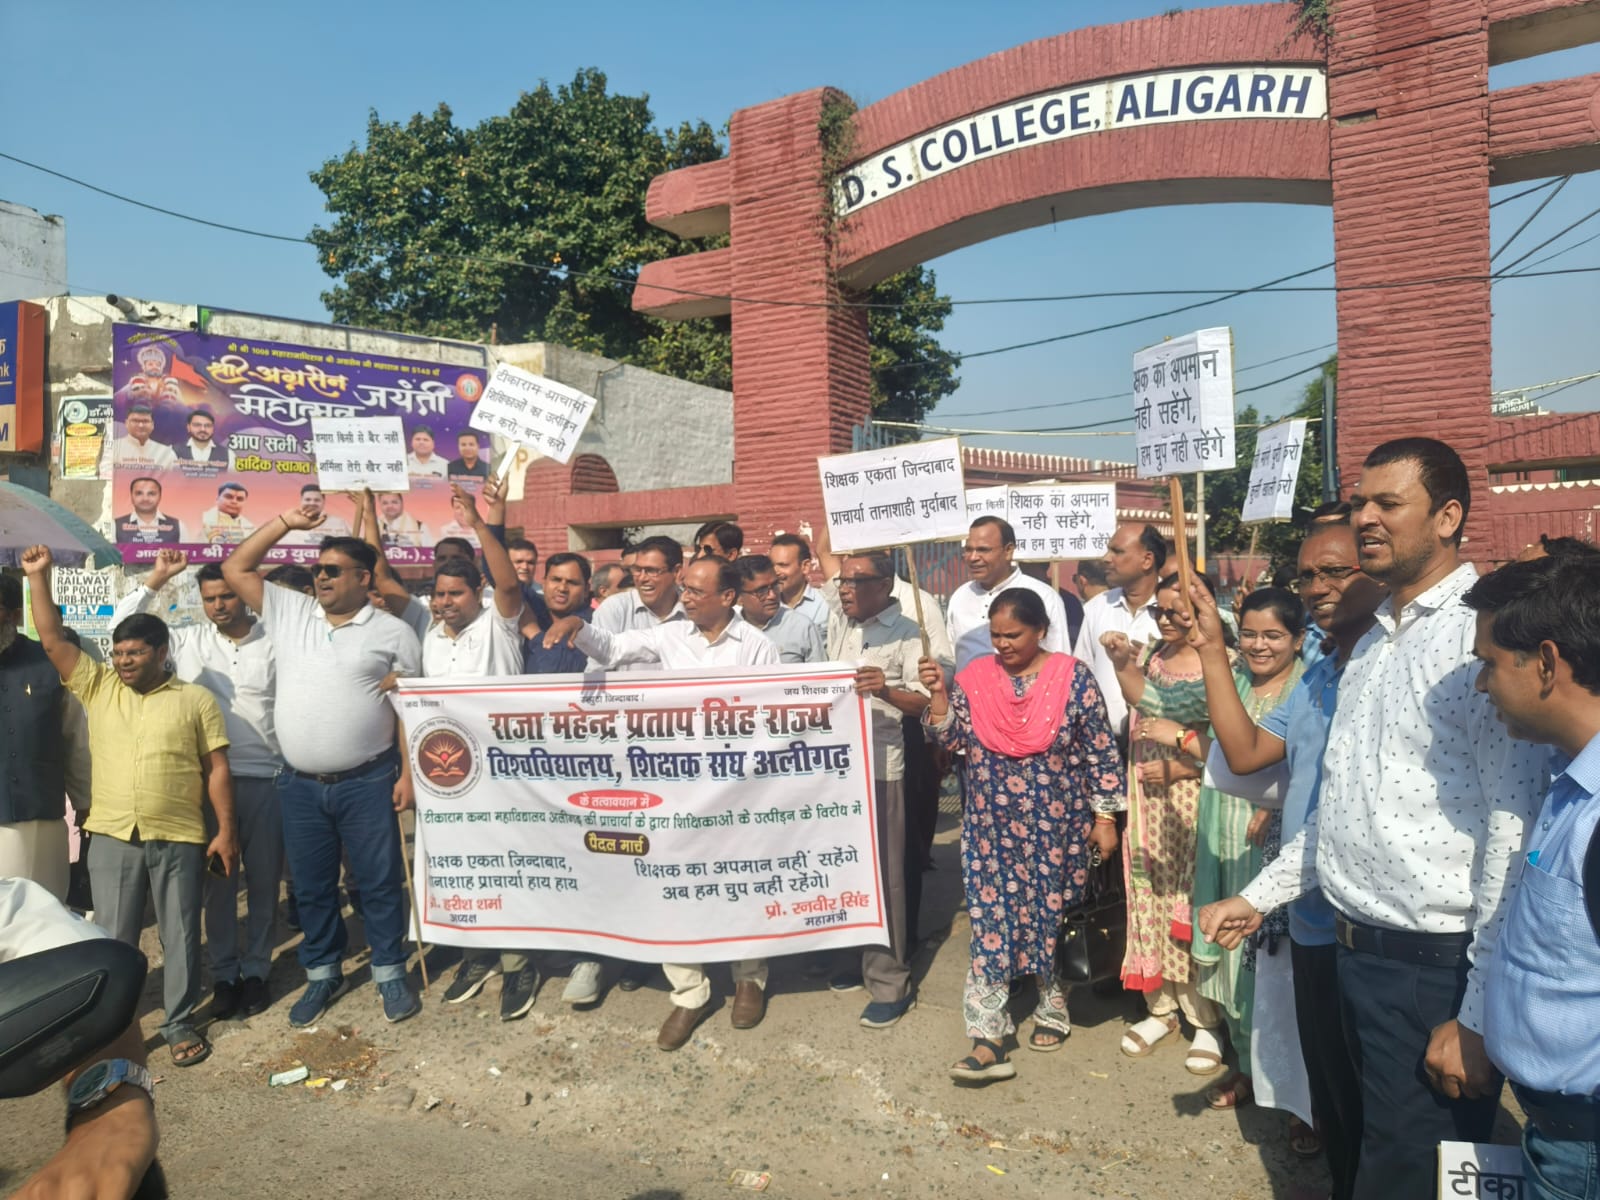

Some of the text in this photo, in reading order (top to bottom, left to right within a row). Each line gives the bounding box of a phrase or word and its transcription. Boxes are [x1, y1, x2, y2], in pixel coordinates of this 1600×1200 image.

[841, 74, 1312, 209] D. S. COLLEGE, ALIGARH
[1170, 350, 1219, 383] अपमान
[353, 379, 454, 416] जयंती
[496, 369, 587, 414] टीकाराम प्राचार्या
[1157, 387, 1197, 424] सहेंगे,
[229, 433, 260, 450] आप
[264, 433, 297, 453] सभी
[547, 436, 566, 452] करो
[1192, 427, 1226, 460] रहेंगे
[236, 455, 272, 472] हार्दिक
[275, 460, 311, 473] स्वागत
[824, 457, 956, 489] शिक्षक एकता जिन्दाबाद
[830, 491, 958, 526] प्राचार्या तानाशाही मुर्दाबाद
[986, 498, 1005, 511] किसी
[1009, 490, 1044, 510] शिक्षक
[1070, 492, 1110, 508] अपमान
[1021, 510, 1095, 531] नही सहेंगे,
[202, 544, 223, 557] श्री
[1031, 538, 1045, 551] हम
[1049, 537, 1065, 555] चुप
[1069, 533, 1087, 550] नही
[57, 576, 110, 585] RAILWAY
[57, 586, 111, 595] UP POLICE
[66, 605, 100, 615] DEV
[783, 687, 800, 697] जय
[802, 685, 829, 696] शिक्षक
[831, 684, 846, 695] संघ
[488, 695, 833, 743] राजा महेन्द्र प्रताप सिंह राज्य
[487, 746, 622, 785] विश्वविद्यालय,
[627, 745, 702, 780] शिक्षक
[706, 743, 749, 780] संघ
[752, 740, 852, 778] अलीगढ़
[579, 795, 590, 808] के
[641, 794, 650, 808] में
[424, 809, 464, 823] टीकाराम
[466, 811, 491, 823] कन्या
[494, 808, 546, 825] महाविद्यालय
[584, 811, 597, 825] की
[600, 812, 632, 828] प्राचार्या
[635, 812, 645, 827] के
[649, 816, 669, 831] द्वारा
[738, 808, 751, 825] के
[754, 807, 796, 826] उत्पीड़न
[799, 804, 812, 820] के
[816, 801, 849, 818] विरोध
[852, 800, 862, 816] में
[589, 832, 644, 852] पैदल मार्च
[467, 855, 505, 870] एकता
[507, 850, 573, 872] जिन्दाबाद,
[633, 846, 859, 879] शिक्षक का अपमान नहीं सहेंगे
[478, 870, 524, 890] प्राचार्या
[527, 876, 552, 891] हाय
[555, 876, 579, 891] हाय
[662, 886, 690, 901] अब
[695, 883, 719, 901] हम
[724, 882, 748, 902] चुप
[753, 874, 784, 894] नहीं
[443, 895, 473, 911] हरीश
[477, 895, 503, 911] शर्मा
[765, 890, 871, 920] प्रो. रनवीर सिंह
[450, 914, 477, 924] अध्यक्ष
[804, 909, 848, 927] महामंत्री
